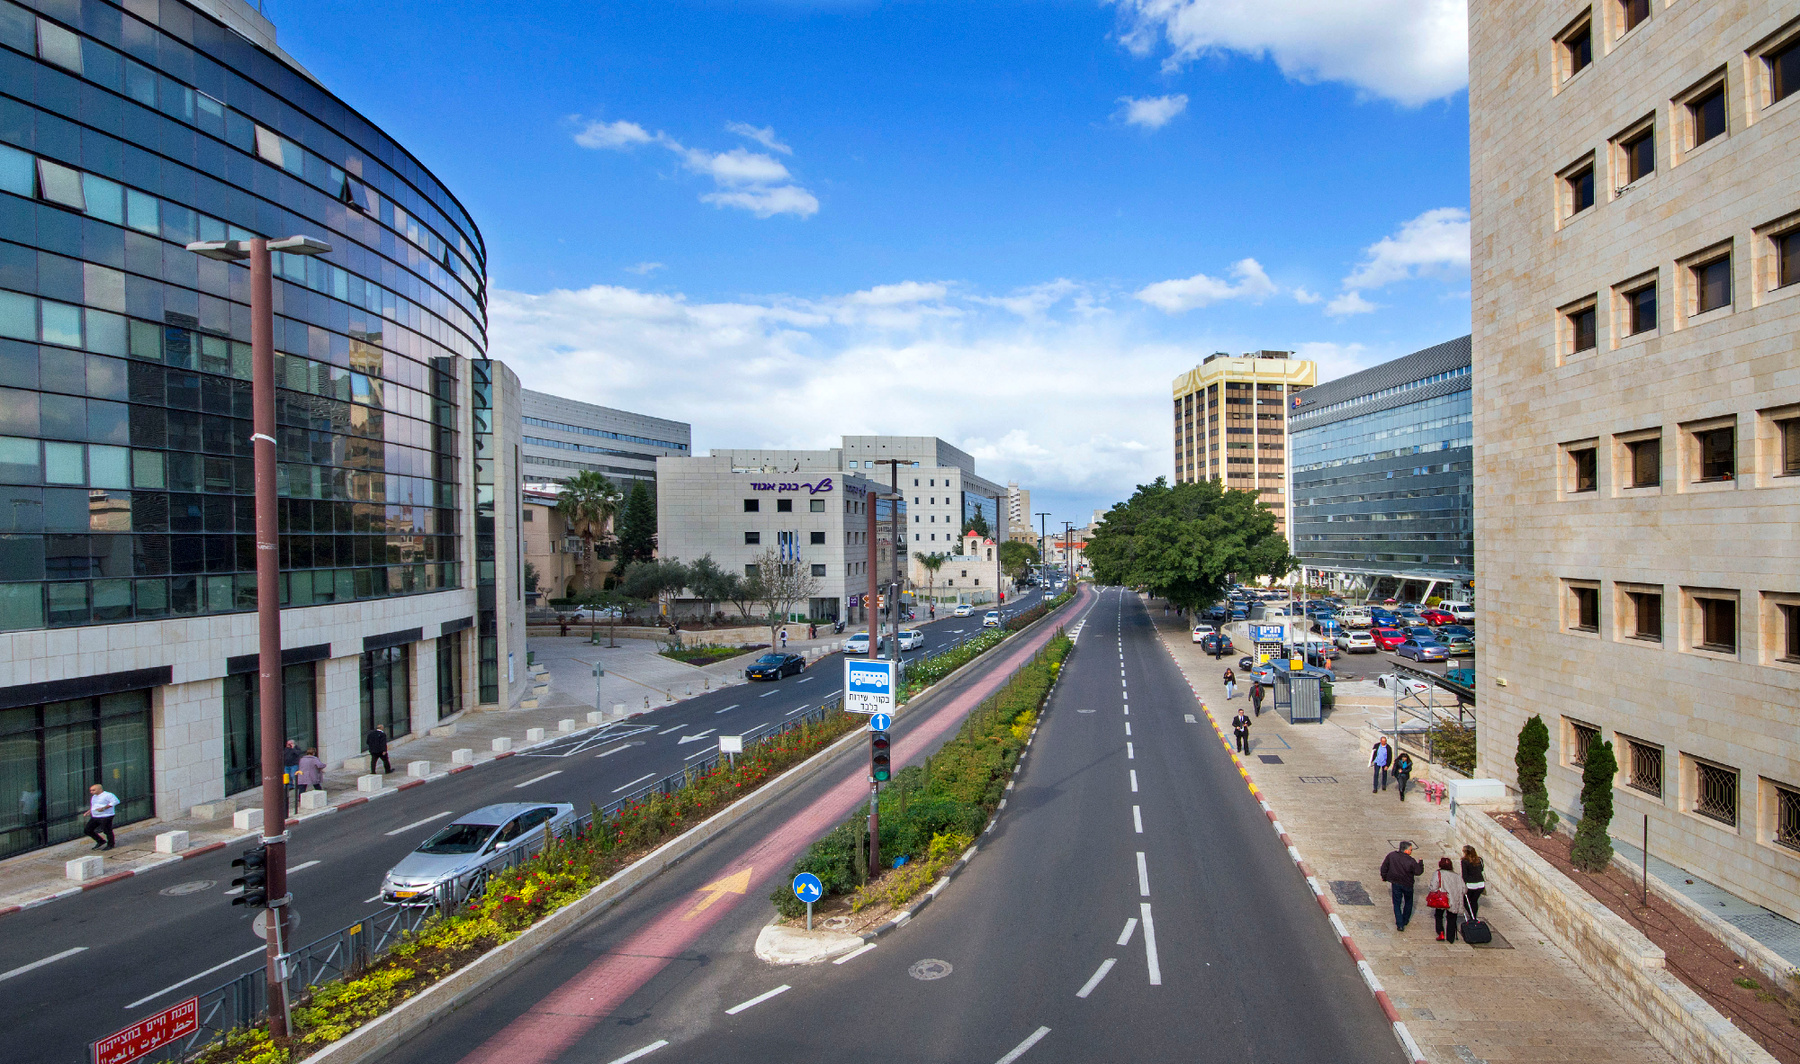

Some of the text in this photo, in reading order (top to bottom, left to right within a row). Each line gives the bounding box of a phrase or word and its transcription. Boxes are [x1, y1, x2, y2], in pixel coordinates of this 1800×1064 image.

[750, 482, 799, 493] בנק אגוד
[1260, 626, 1281, 635] חניון
[849, 693, 869, 701] שירות
[860, 702, 878, 711] בלבד
[171, 1002, 194, 1021] סכנת
[146, 1014, 167, 1032] חיים
[169, 1016, 194, 1039] خطر
[140, 1028, 166, 1050] الموت
